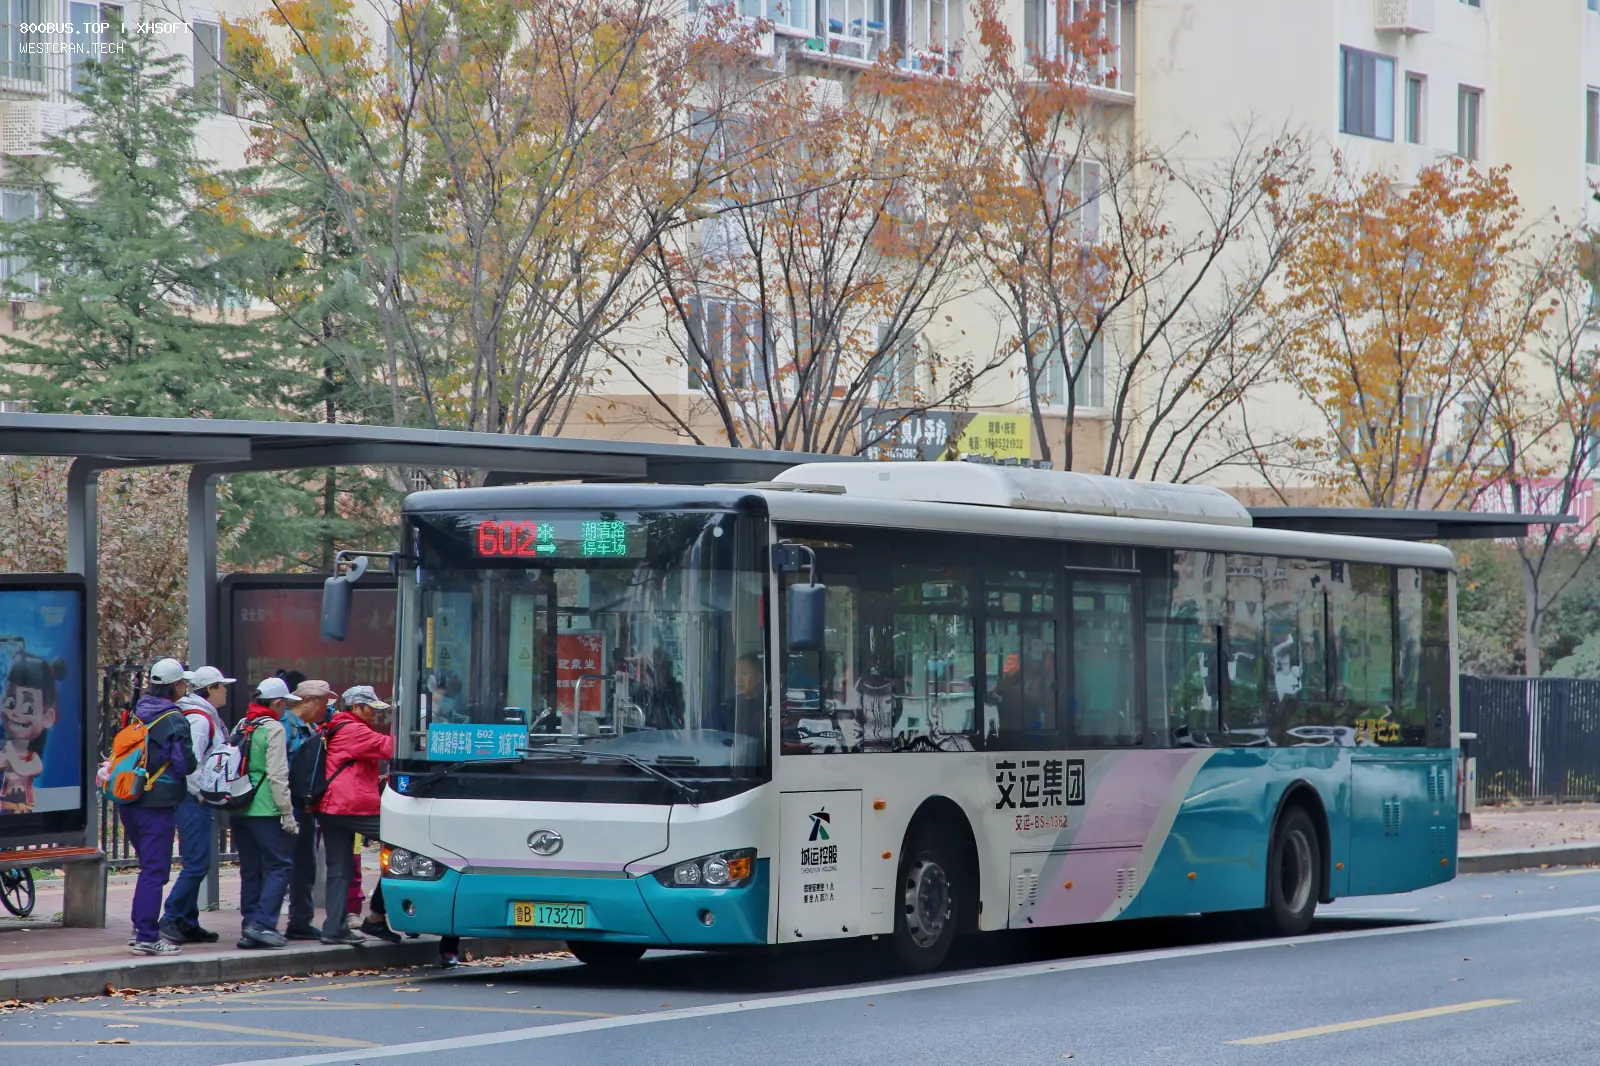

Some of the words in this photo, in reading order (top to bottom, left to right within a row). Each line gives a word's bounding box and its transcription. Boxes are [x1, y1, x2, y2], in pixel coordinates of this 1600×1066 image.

[478, 520, 537, 556] 602
[582, 520, 626, 538] 湖清路
[583, 538, 627, 556] 停车场
[476, 729, 495, 739] 602
[995, 759, 1085, 809] 交运集团
[1015, 815, 1068, 831] 交运-BS-1362
[800, 845, 838, 866] 城运控股
[516, 906, 532, 923] 鲁B
[538, 906, 584, 925] 17327D
